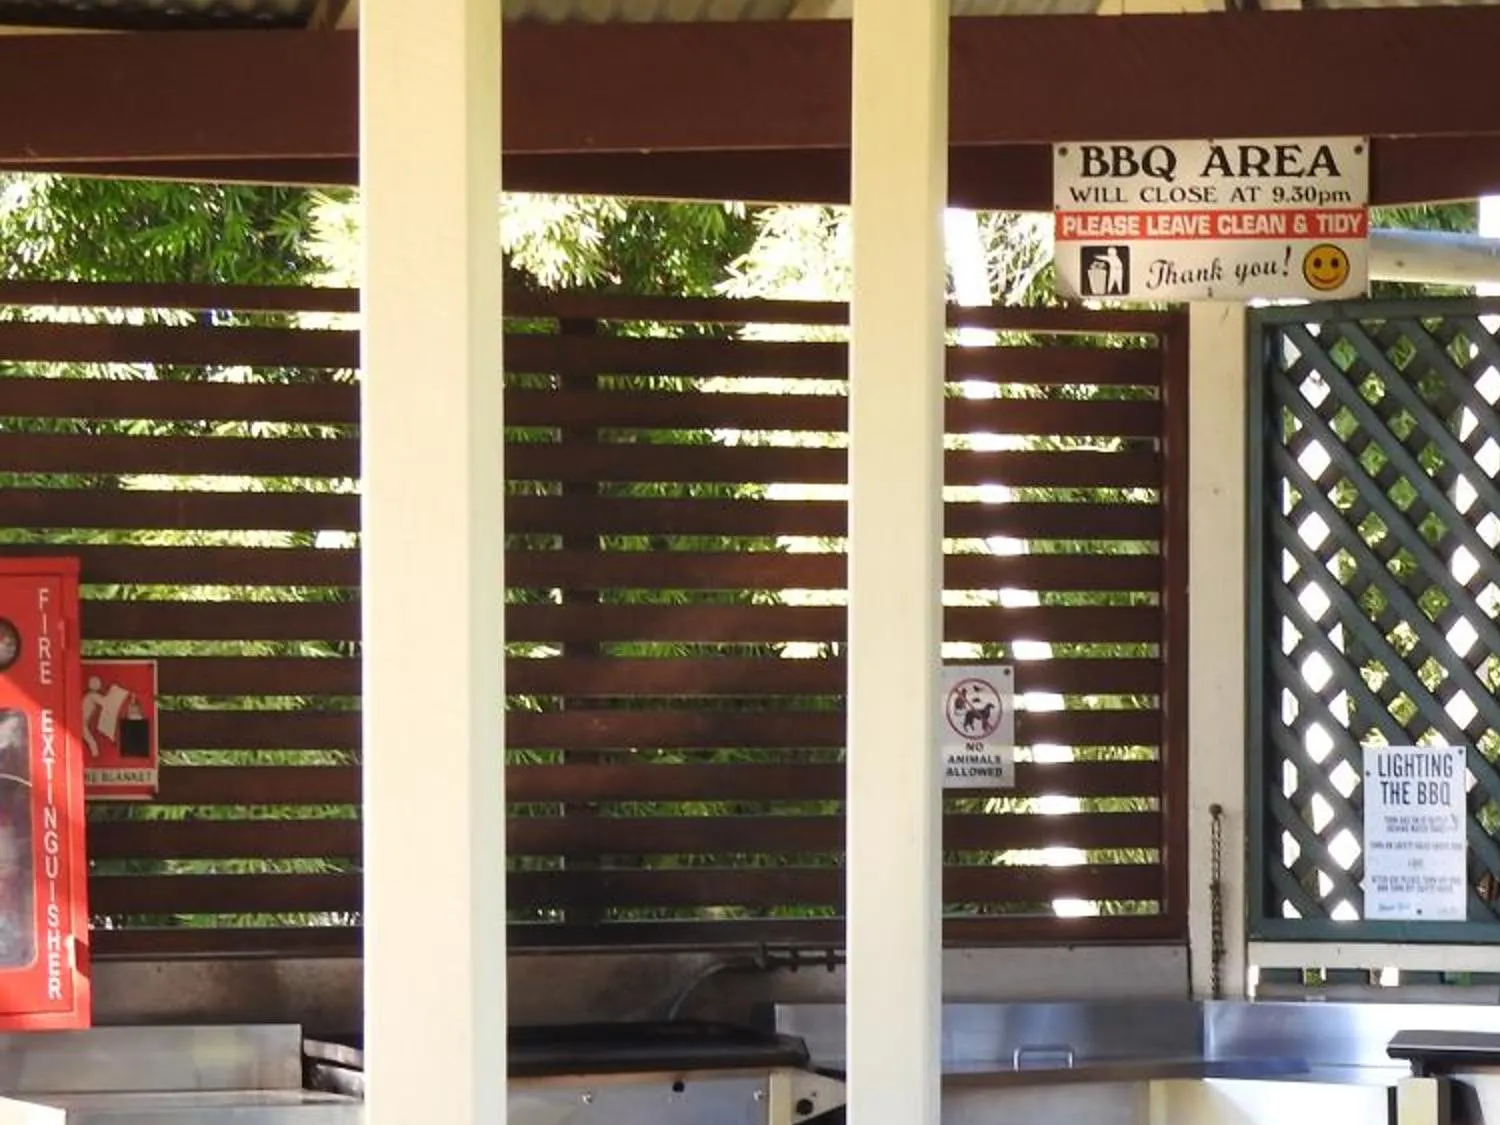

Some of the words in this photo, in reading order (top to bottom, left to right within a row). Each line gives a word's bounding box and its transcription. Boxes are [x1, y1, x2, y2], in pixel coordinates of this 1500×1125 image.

[1080, 145, 1177, 182] BBQ
[1201, 144, 1341, 178] AREA
[1070, 186, 1128, 204] WILL
[1139, 186, 1217, 204] CLOSE
[1231, 186, 1263, 203] AT
[1272, 185, 1352, 206] 9.30pm
[1062, 215, 1140, 237] PLEASE
[1146, 214, 1211, 236] LEAVE
[1217, 214, 1286, 235] CLEAN
[1293, 214, 1307, 234] &
[1315, 212, 1363, 234] TIDY
[1146, 258, 1223, 289] Thank
[1234, 246, 1292, 286] you!
[37, 588, 52, 686] FIRE
[948, 755, 1002, 765] ANIMALS
[966, 742, 984, 753] NO
[946, 767, 1002, 777] ALLOWED
[1378, 753, 1453, 778] LIGHTING
[1380, 781, 1411, 805] THE
[1417, 781, 1451, 806] BBQ
[40, 708, 62, 1000] EXTINGUISHER
